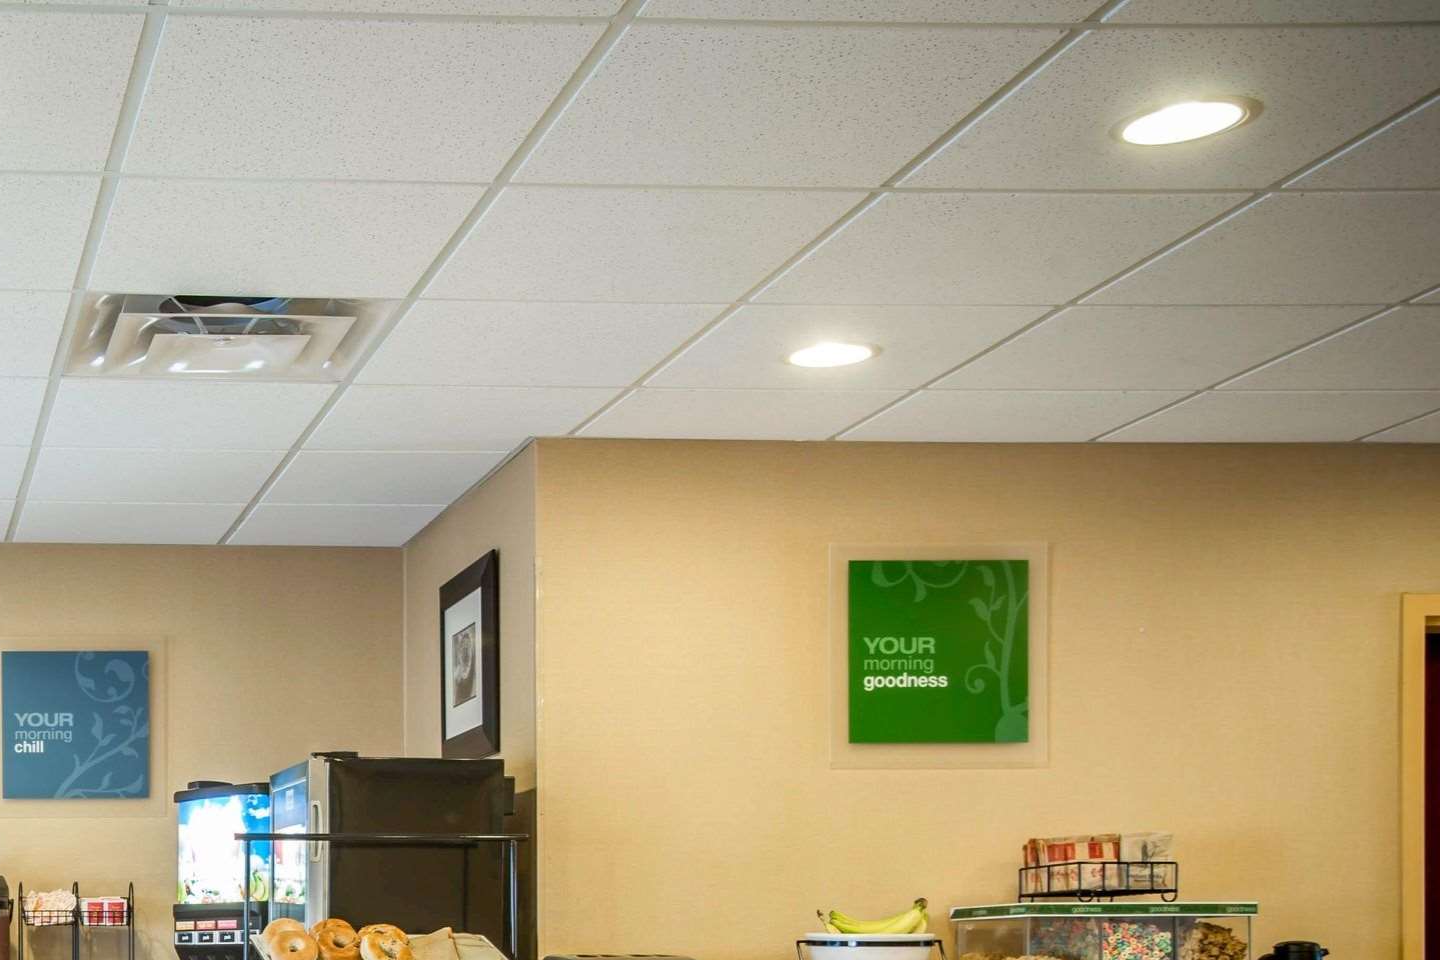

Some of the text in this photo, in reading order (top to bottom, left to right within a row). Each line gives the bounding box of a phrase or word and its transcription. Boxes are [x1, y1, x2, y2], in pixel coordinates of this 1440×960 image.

[863, 636, 936, 655] YOUR
[863, 655, 934, 674] morning
[863, 672, 949, 692] goodness
[14, 712, 74, 727] YOUR
[15, 728, 73, 743] morning
[14, 740, 44, 753] chill
